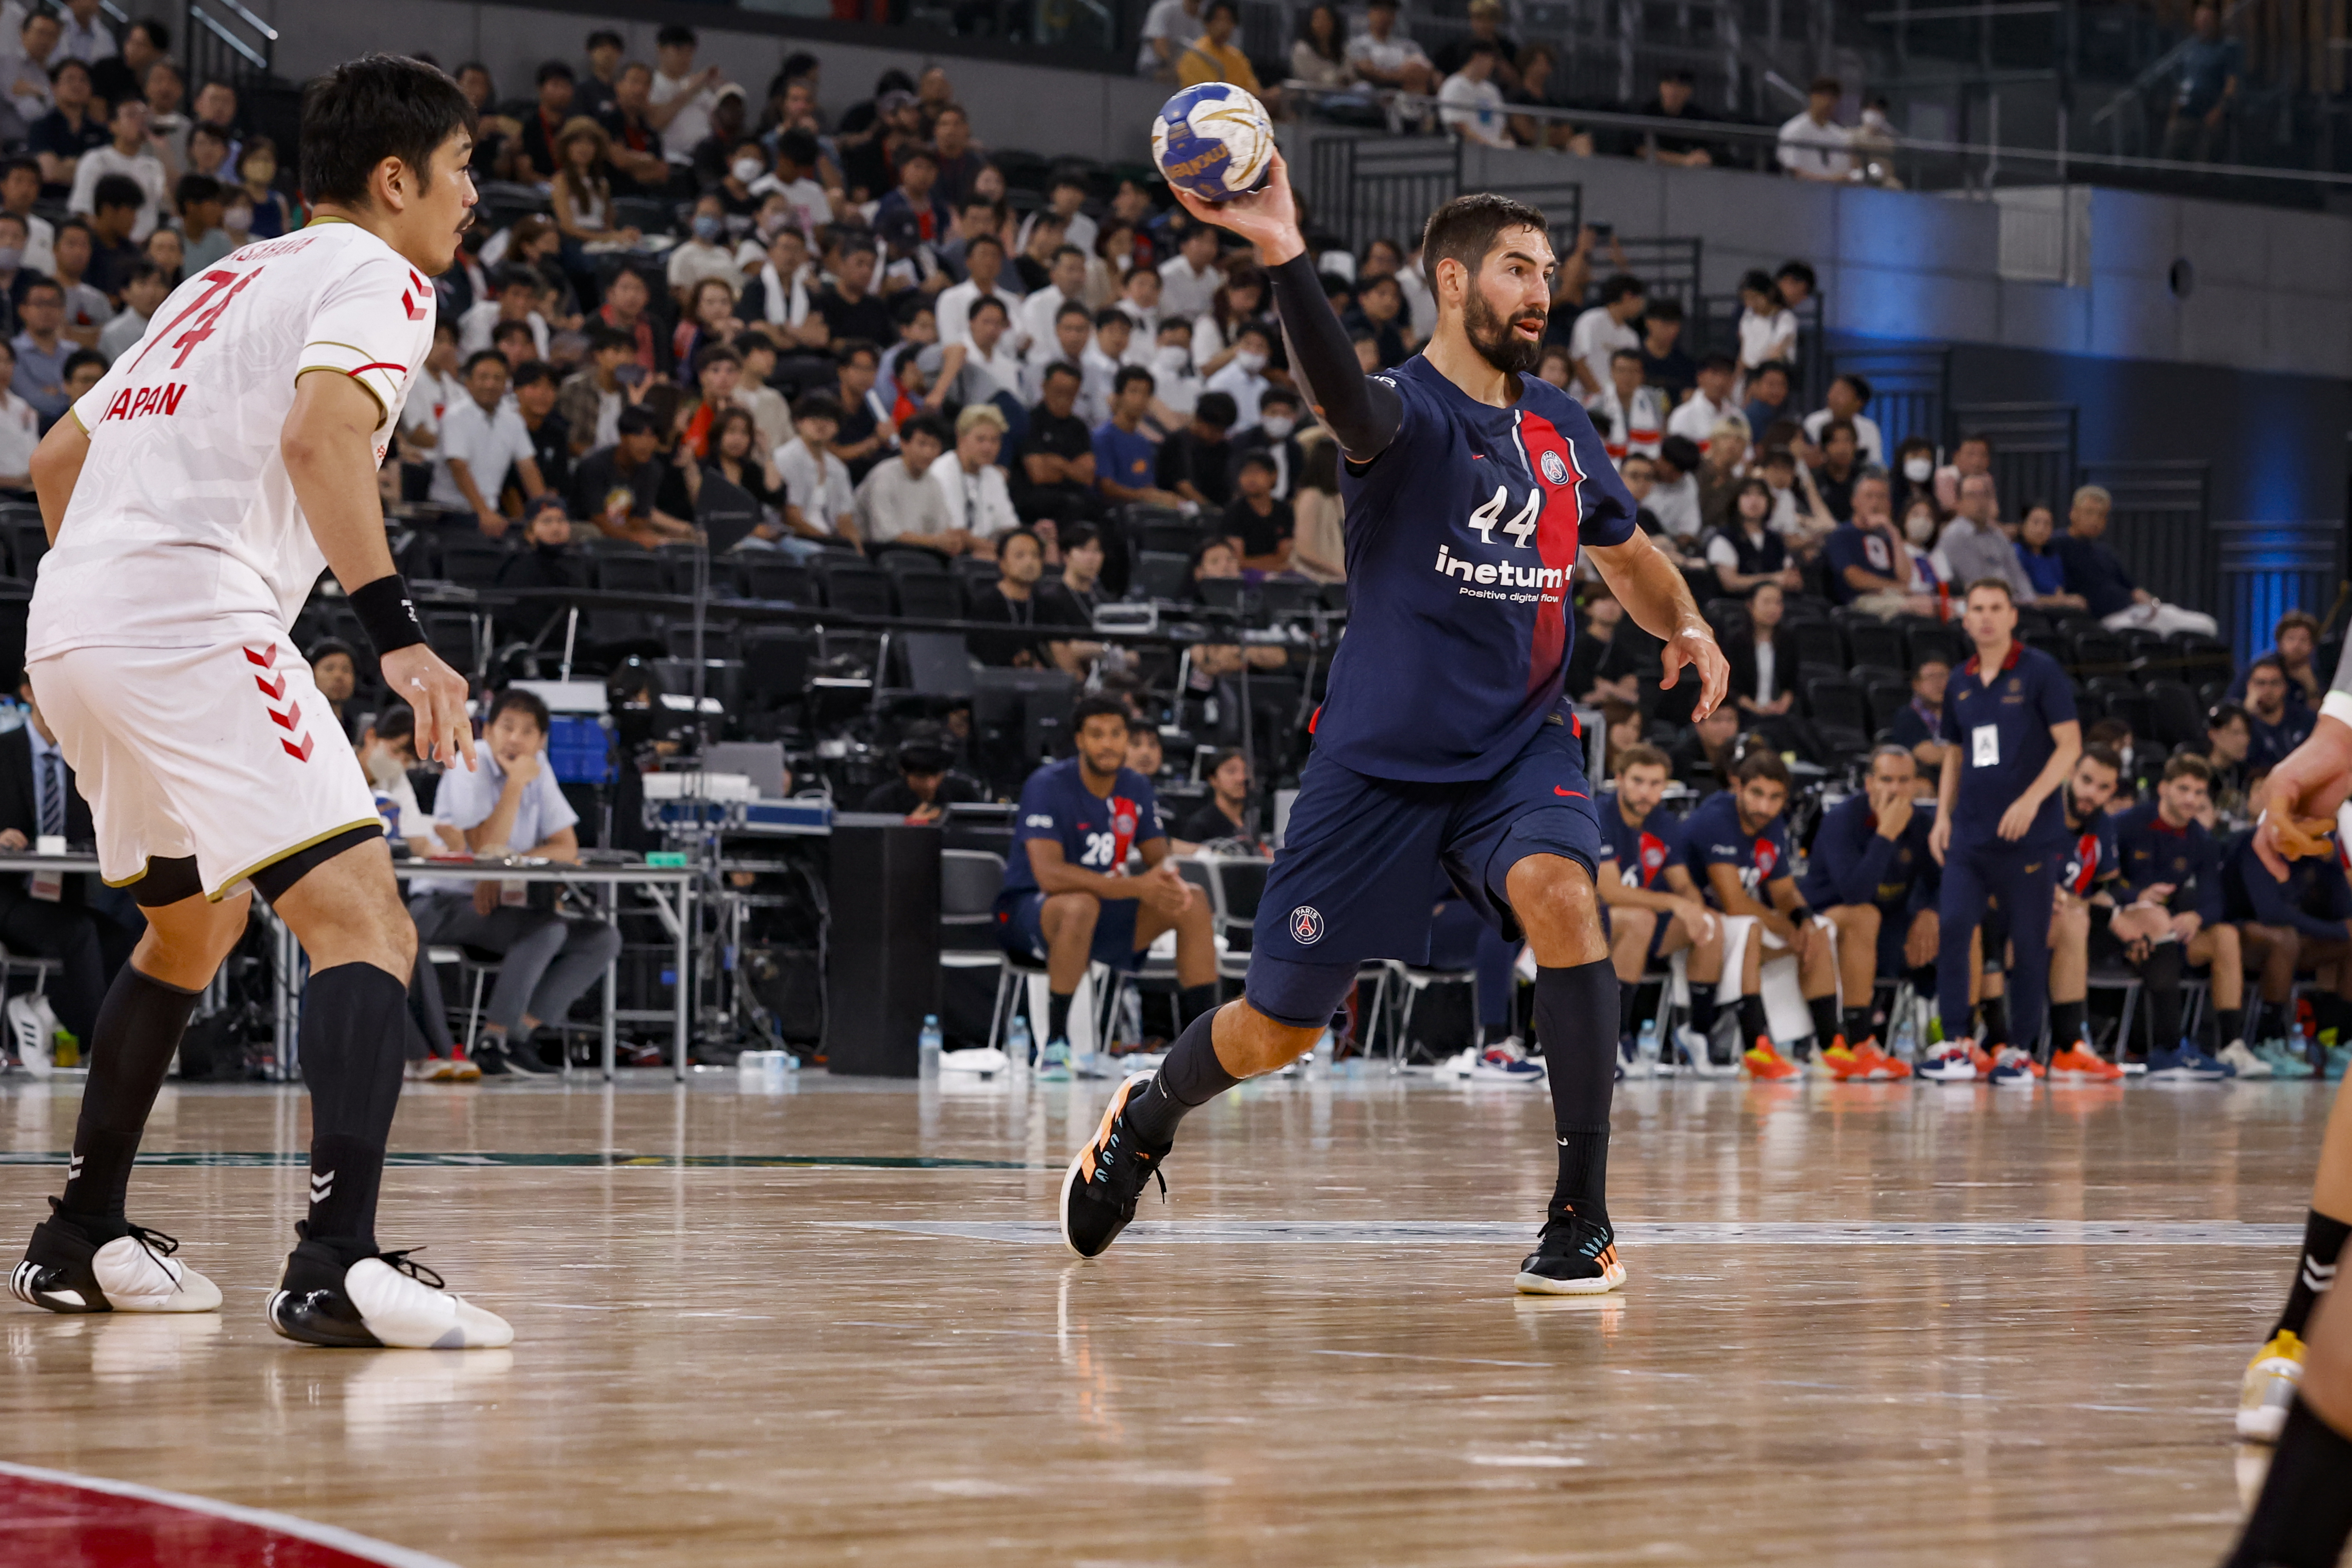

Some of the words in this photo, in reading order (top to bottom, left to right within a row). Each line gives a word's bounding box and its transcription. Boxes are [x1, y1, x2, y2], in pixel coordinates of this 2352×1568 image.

[126, 265, 267, 375] 74
[1543, 452, 1558, 461] PARIS
[1468, 485, 1540, 548] 44
[1459, 587, 1506, 600] Positive
[1509, 593, 1539, 604] digital
[1541, 594, 1559, 603] flow
[1080, 832, 1116, 866] 28
[1296, 908, 1318, 919] PARIS
